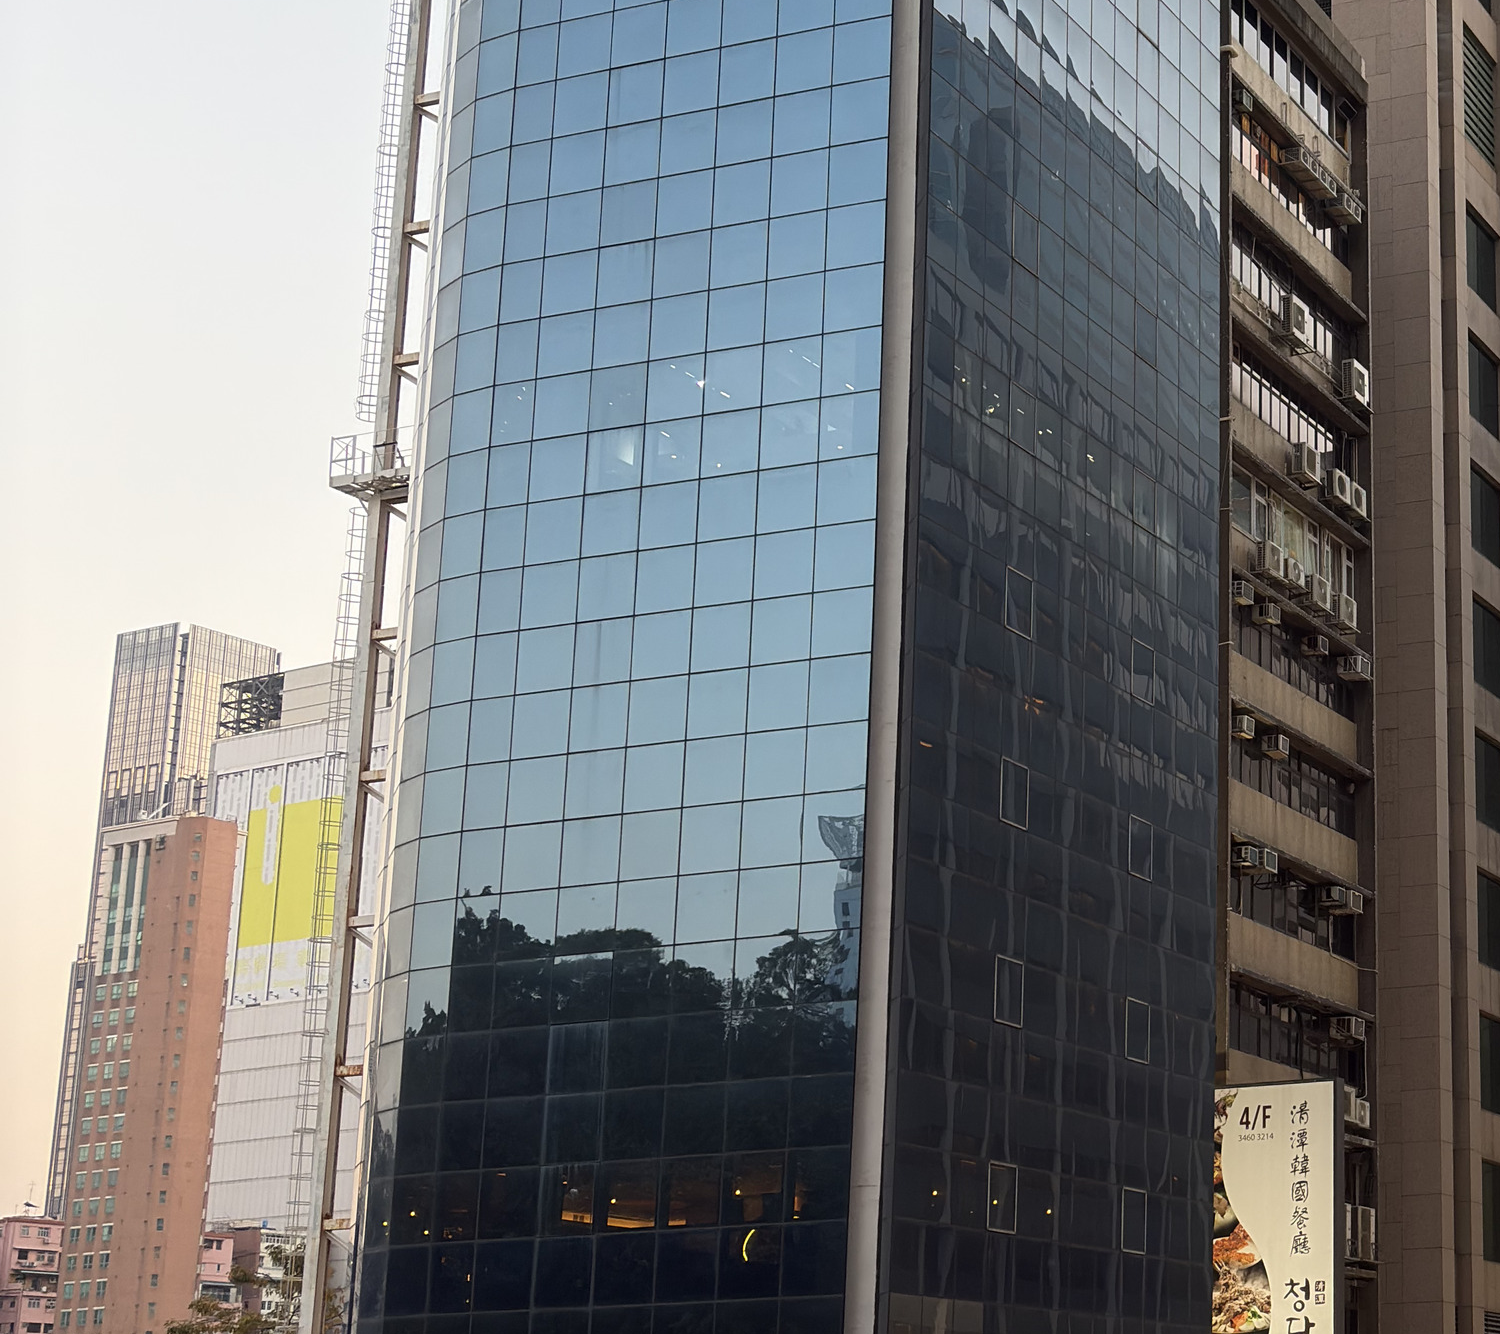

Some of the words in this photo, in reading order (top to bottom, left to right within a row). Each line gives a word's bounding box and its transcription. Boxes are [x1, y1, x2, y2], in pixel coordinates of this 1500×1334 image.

[1239, 1105, 1272, 1131] 4/F
[1238, 1134, 1255, 1142] 3460
[1256, 1132, 1274, 1141] 3214
